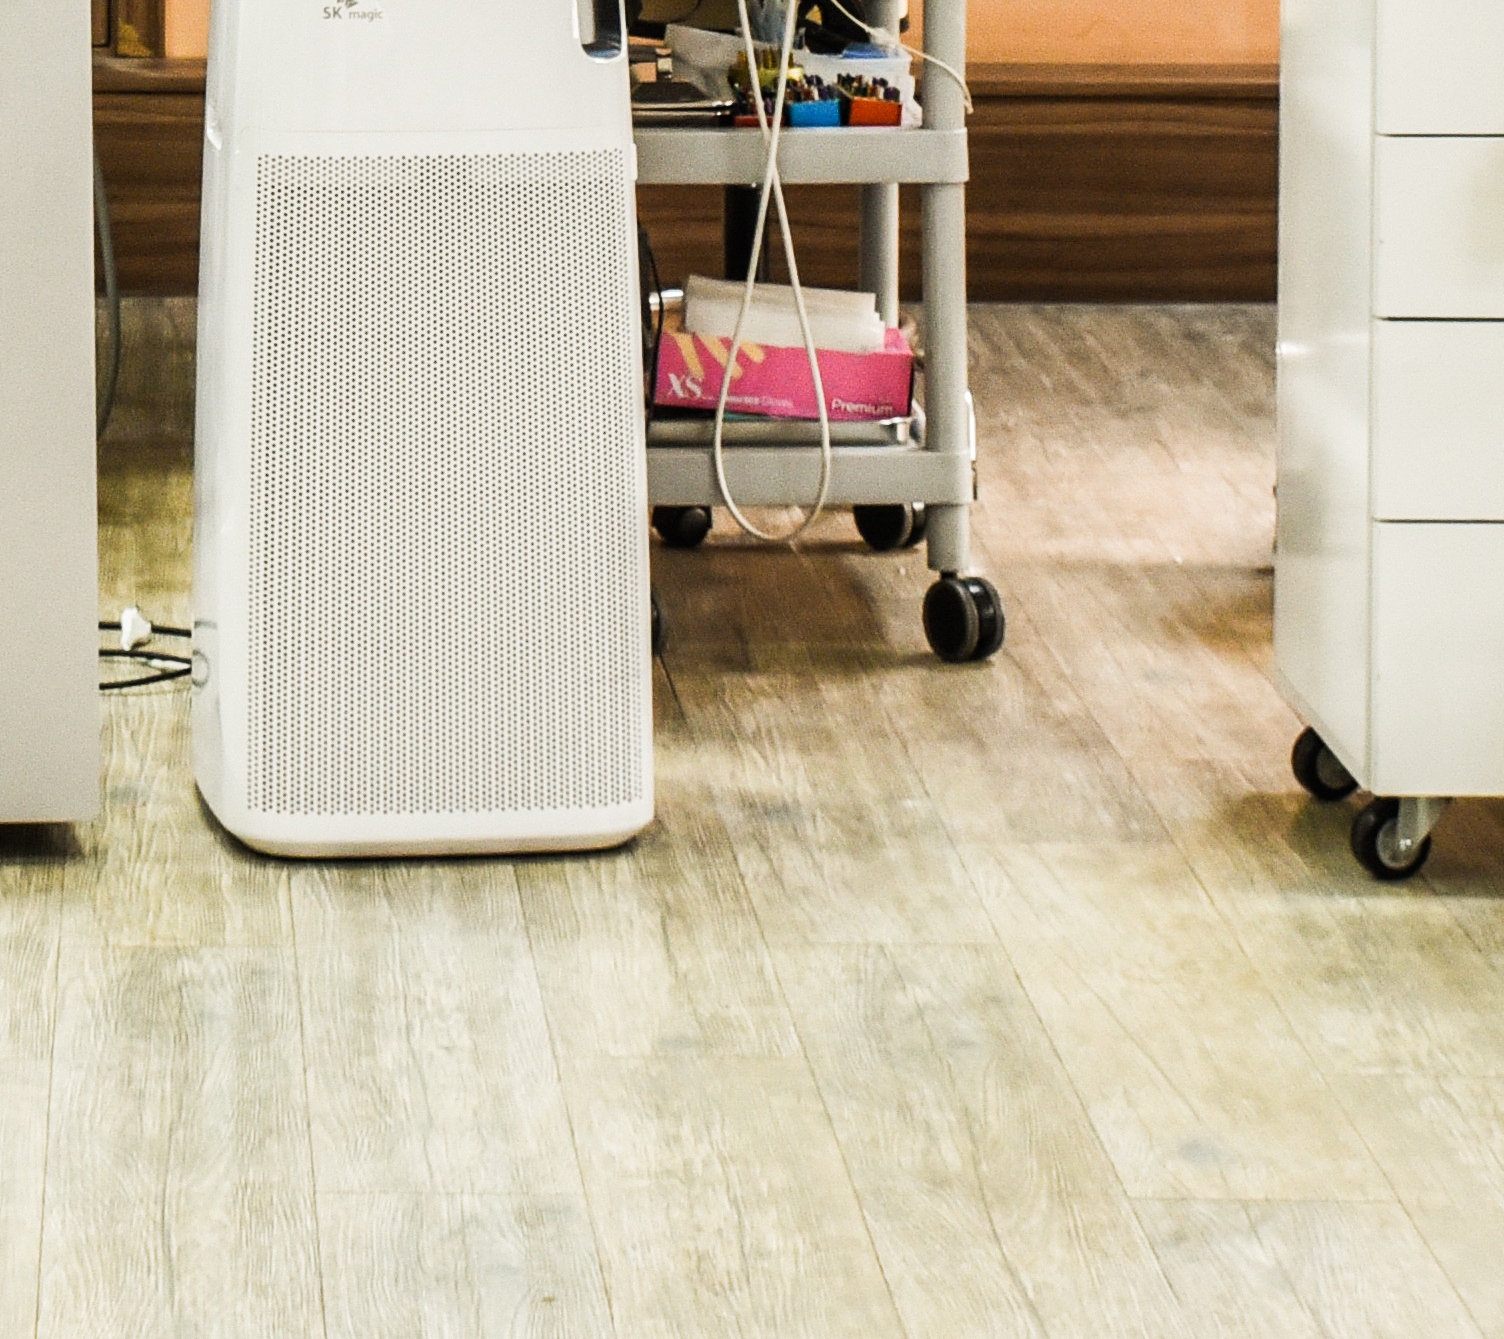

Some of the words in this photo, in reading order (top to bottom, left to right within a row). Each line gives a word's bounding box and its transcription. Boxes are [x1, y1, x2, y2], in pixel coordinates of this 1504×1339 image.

[323, 6, 342, 20] SK
[348, 8, 383, 23] magic
[668, 373, 703, 399] XS
[831, 398, 893, 415] Premium
